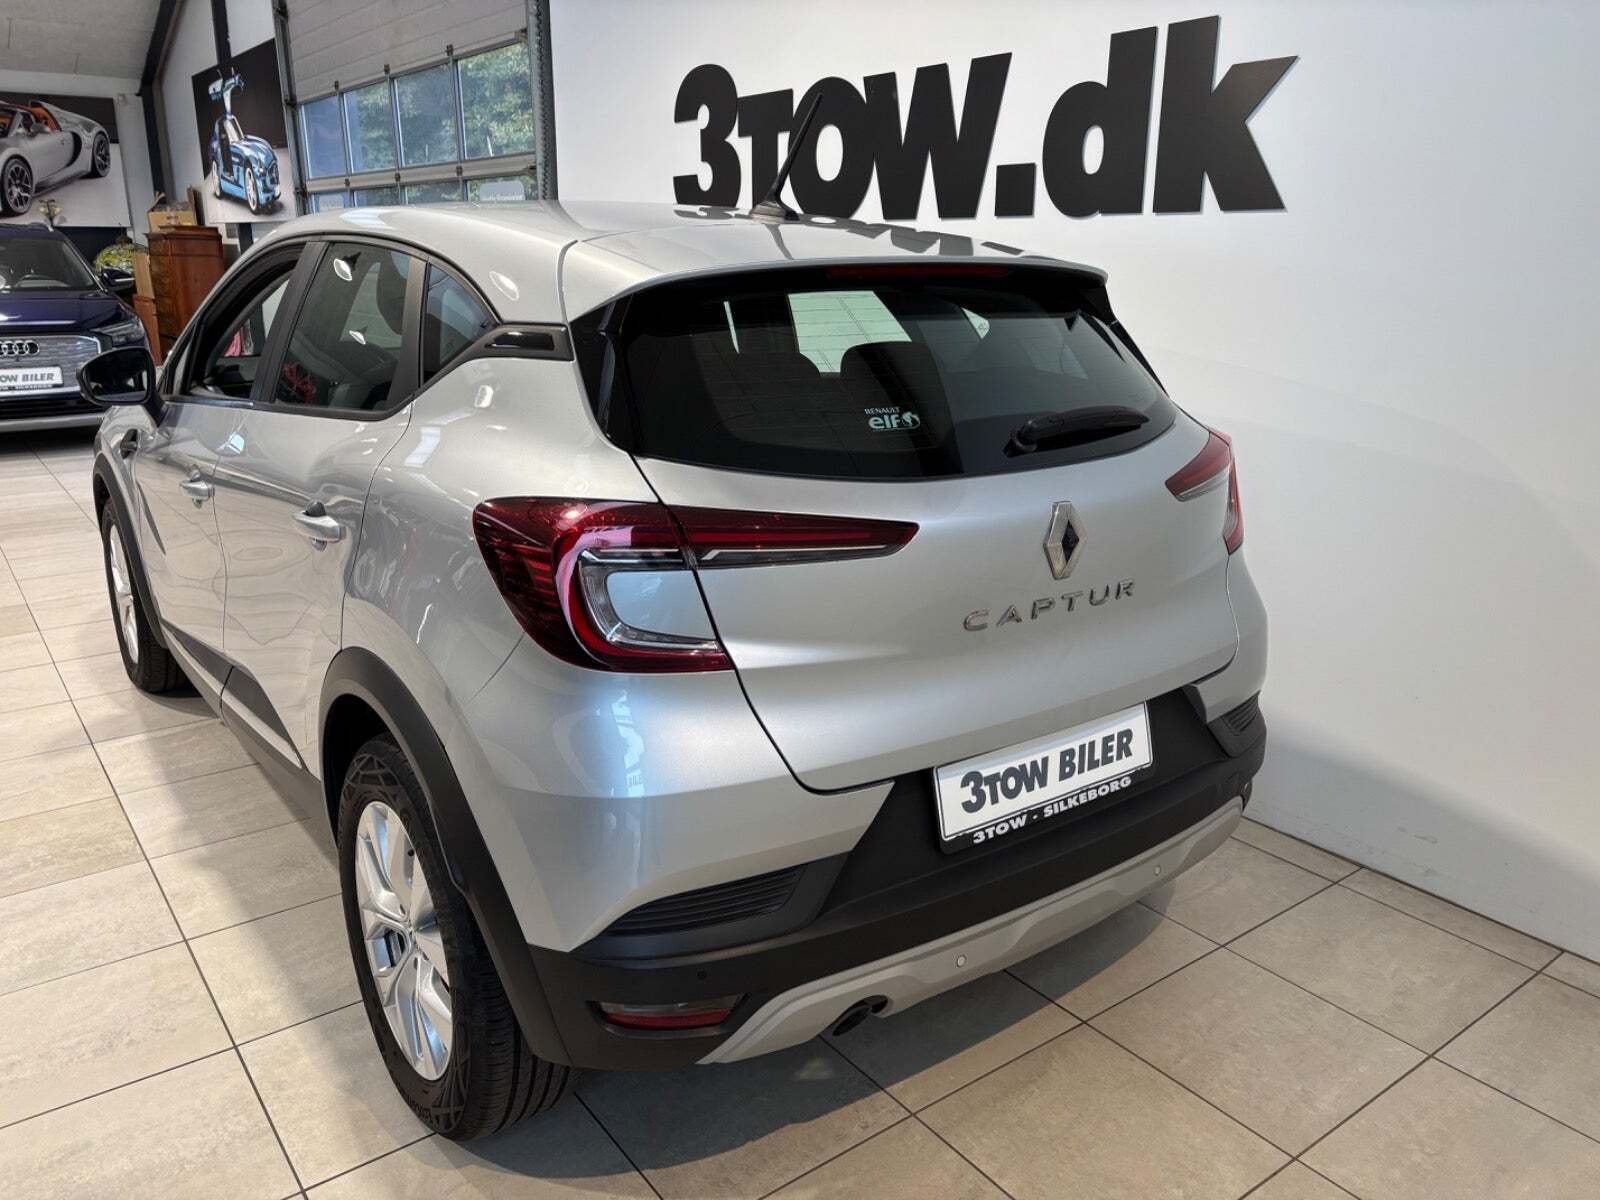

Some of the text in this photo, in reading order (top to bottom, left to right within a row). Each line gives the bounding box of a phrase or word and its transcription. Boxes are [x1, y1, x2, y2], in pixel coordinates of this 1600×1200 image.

[22, 372, 54, 382] BILER
[864, 406, 900, 415] RENAULT
[868, 414, 900, 429] elf
[963, 579, 1135, 632] CAPTUR
[960, 728, 1134, 814] 3TOW BILER
[973, 776, 1132, 844] 3TOW SILKEBORG
